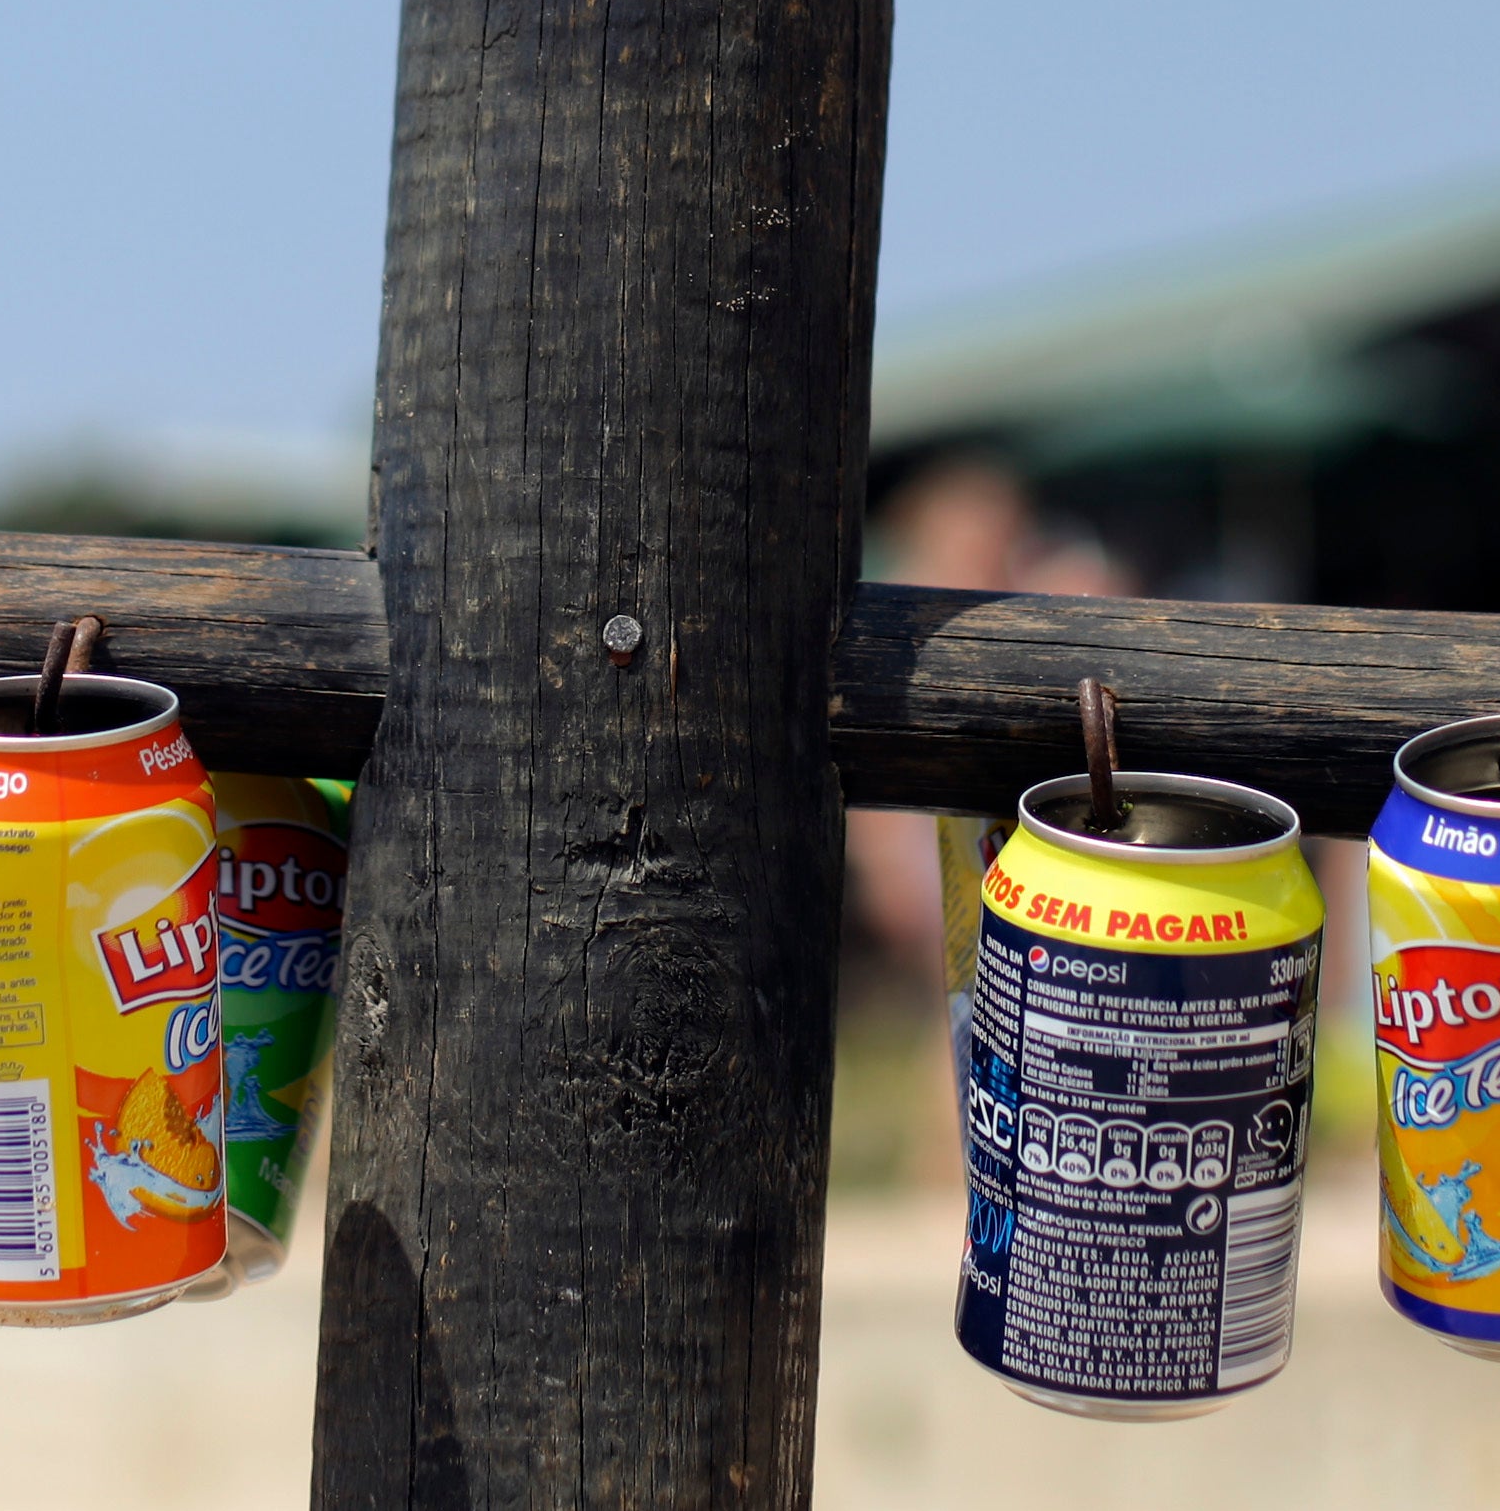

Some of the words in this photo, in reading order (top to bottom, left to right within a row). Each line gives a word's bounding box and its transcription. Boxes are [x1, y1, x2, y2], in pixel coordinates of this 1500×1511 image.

[139, 731, 193, 776] Pêsseg
[1421, 815, 1497, 856] Limão
[219, 847, 346, 911] ipto
[118, 889, 218, 983] Lipt
[1026, 893, 1092, 933] SEM
[1106, 910, 1248, 943] PAGAR!
[219, 944, 271, 987] ce
[276, 936, 341, 988] Tea
[1052, 955, 1127, 985] pepsi
[1026, 992, 1100, 1021] REFRIGERANTE
[1103, 1006, 1119, 1023] DE
[1122, 1008, 1190, 1029] EXTRACTOS
[1193, 1011, 1247, 1028] VEGETAIS.
[1027, 978, 1077, 1003] CONSUMIR
[1080, 991, 1094, 1006] DE
[1098, 993, 1177, 1014] PREFERÊNCIA
[1181, 998, 1216, 1014] ANTES
[1219, 998, 1237, 1010] DE:
[1240, 994, 1260, 1009] VER
[1396, 1072, 1456, 1124] Ice
[1028, 1125, 1047, 1143] 146
[1059, 1135, 1096, 1157] 36,4g
[1113, 1142, 1132, 1159] 0g
[1159, 1144, 1177, 1162] 0g
[1035, 1209, 1092, 1230] DEPÓSITO
[1093, 1221, 1126, 1235] TARA
[1129, 1223, 1183, 1237] PERDIDA
[1013, 1228, 1102, 1262] INGREDIENTES:
